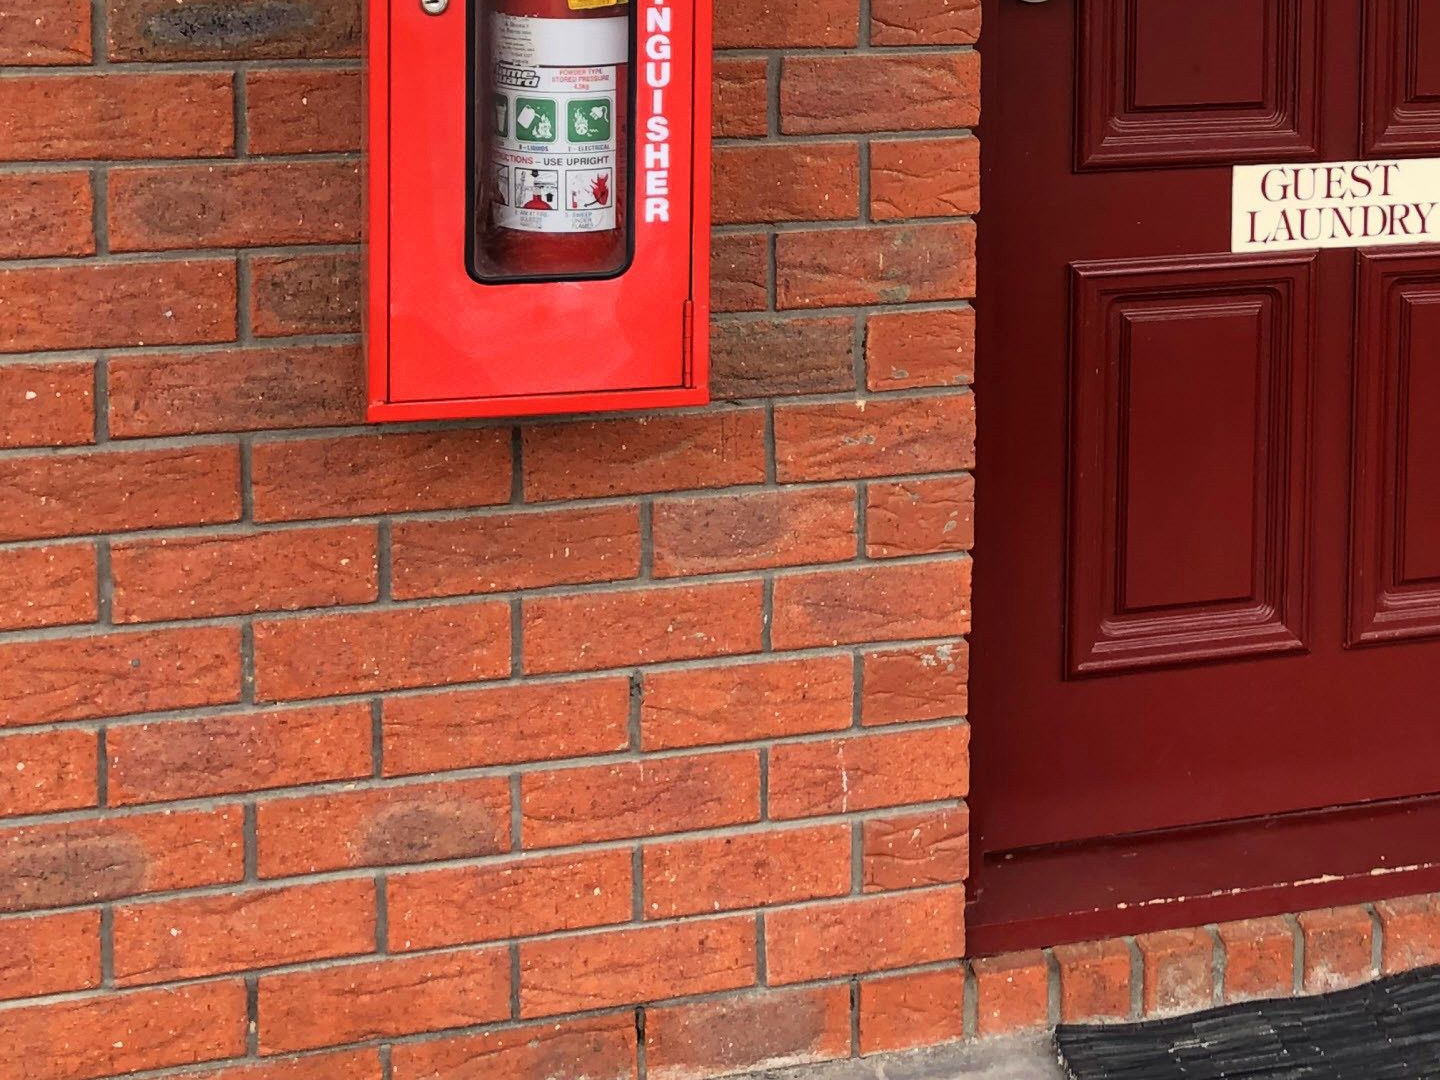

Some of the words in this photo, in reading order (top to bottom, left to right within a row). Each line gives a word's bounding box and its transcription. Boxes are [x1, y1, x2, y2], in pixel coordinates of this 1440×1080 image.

[543, 158, 563, 166] USE
[566, 155, 610, 166] UPRIGHT
[1260, 163, 1401, 202] GUEST
[1245, 201, 1439, 244] LAUNDRY
